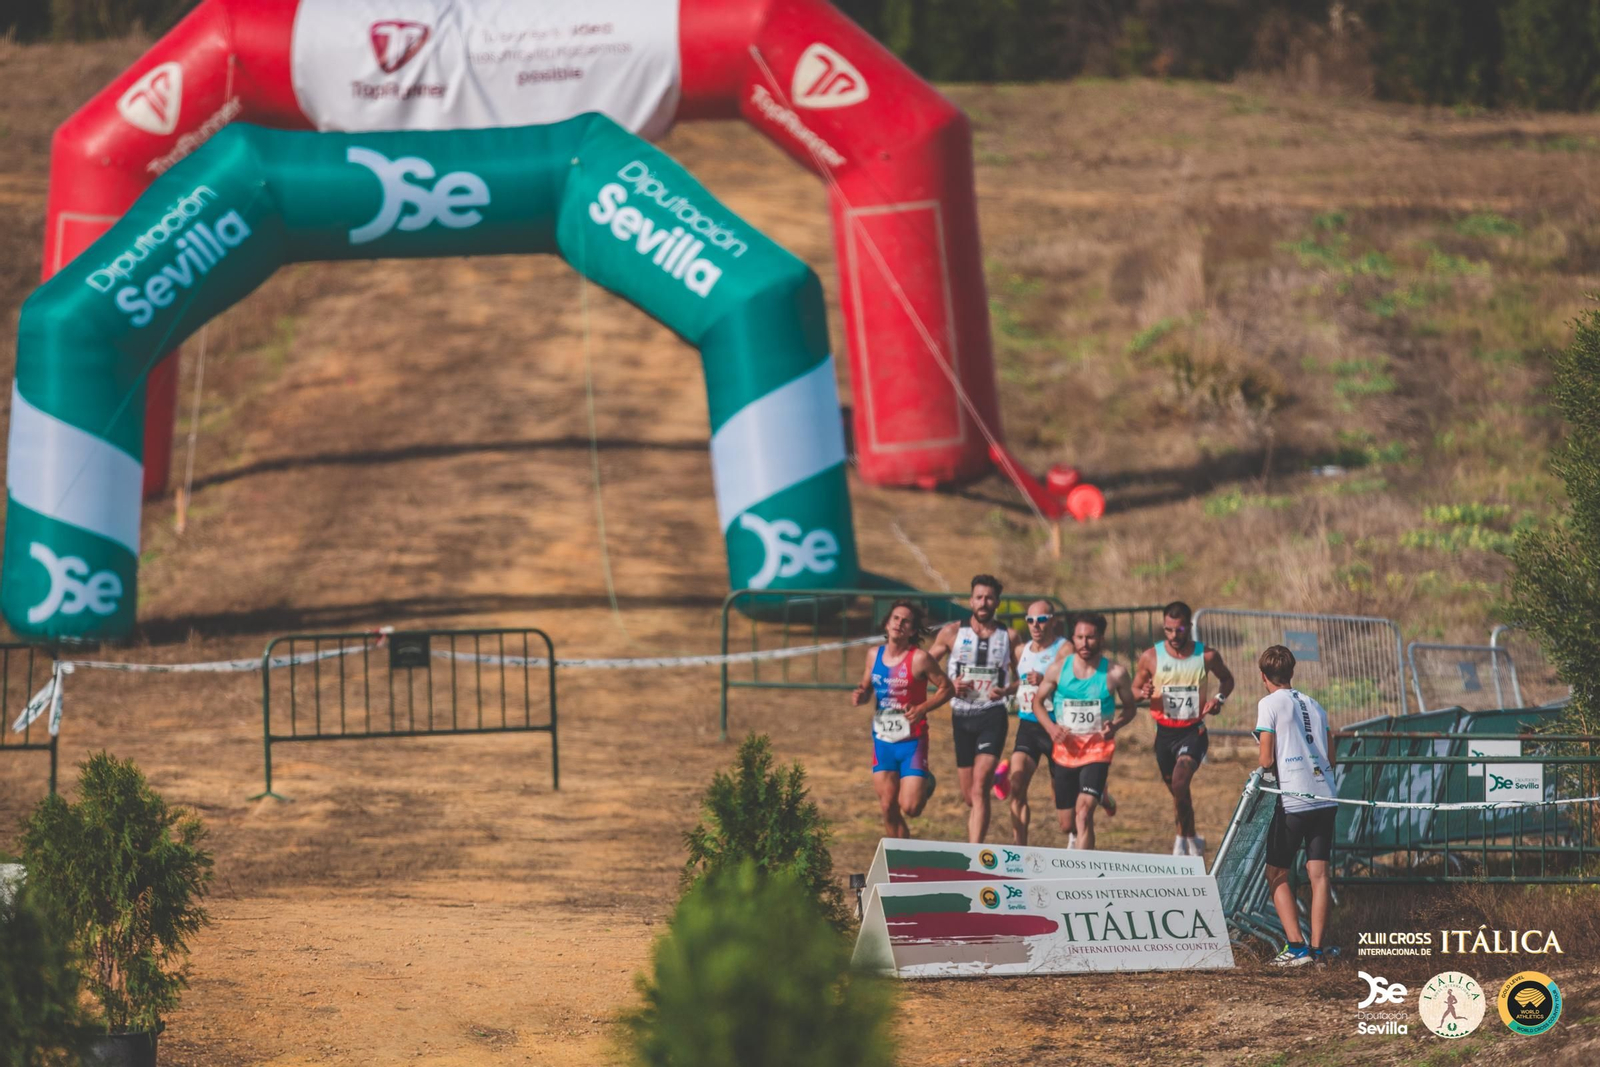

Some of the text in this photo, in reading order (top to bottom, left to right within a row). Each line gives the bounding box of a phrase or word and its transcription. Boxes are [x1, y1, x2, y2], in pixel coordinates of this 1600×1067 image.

[617, 159, 748, 258] Diputación
[85, 184, 219, 293] Diputación
[588, 182, 723, 298] Sevilla
[115, 208, 251, 328] Sevilla
[1169, 697, 1193, 709] 574
[1070, 711, 1095, 723] 730
[880, 720, 903, 732] 125
[1515, 782, 1540, 790] Sevilla
[1051, 858, 1087, 869] CROSS
[1089, 861, 1179, 875] INTERNACIONAL
[1181, 866, 1195, 876] DE
[1056, 890, 1093, 900] CROSS
[1095, 888, 1190, 900] INTERNACIONAL
[1192, 887, 1208, 897] DE
[1061, 902, 1216, 943] ITÁLICA
[1068, 941, 1219, 955] INTERNATIONAL CROSS COUNTRY
